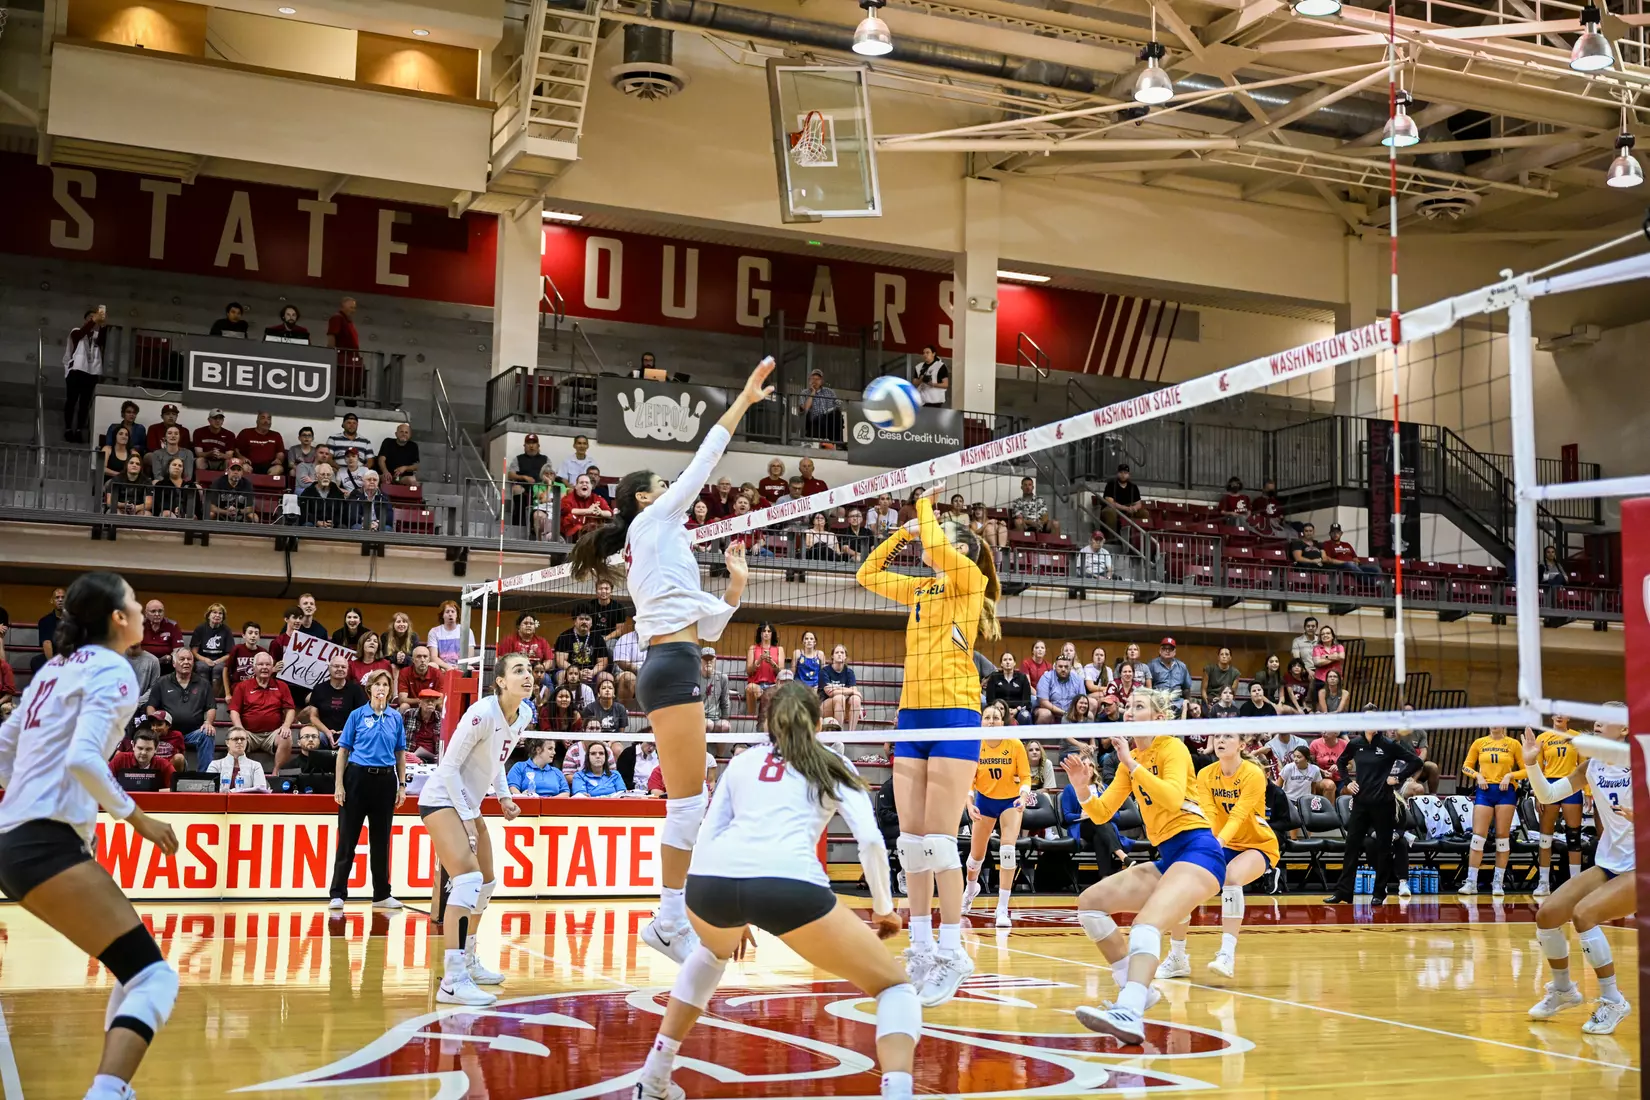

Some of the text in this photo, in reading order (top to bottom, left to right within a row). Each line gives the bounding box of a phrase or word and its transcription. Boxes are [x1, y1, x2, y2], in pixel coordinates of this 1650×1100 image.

[49, 166, 412, 288] STATE
[540, 229, 955, 350] OUGARS
[1269, 322, 1390, 376] WASHINGTON STATE
[634, 401, 691, 433] ZEPPOZ
[1093, 385, 1183, 428] WASHINGTON STATE
[877, 429, 960, 446] Gesa Credit Union
[959, 432, 1028, 467] WASHINGTON STATE
[852, 468, 909, 497] WASHINGTON STATE
[766, 496, 812, 520] WASHINGTON STATE
[292, 632, 318, 657] WE
[237, 656, 256, 667] WS
[24, 677, 58, 731] 12
[500, 739, 512, 762] 5
[979, 757, 1013, 765] BAKERSFIELD
[1489, 753, 1499, 764] 11
[1556, 746, 1567, 758] 17
[758, 752, 786, 783] 8
[988, 767, 1002, 780] 10
[1596, 775, 1631, 789] Runners
[1138, 784, 1153, 806] 5
[94, 822, 655, 889] WASHINGO STATE
